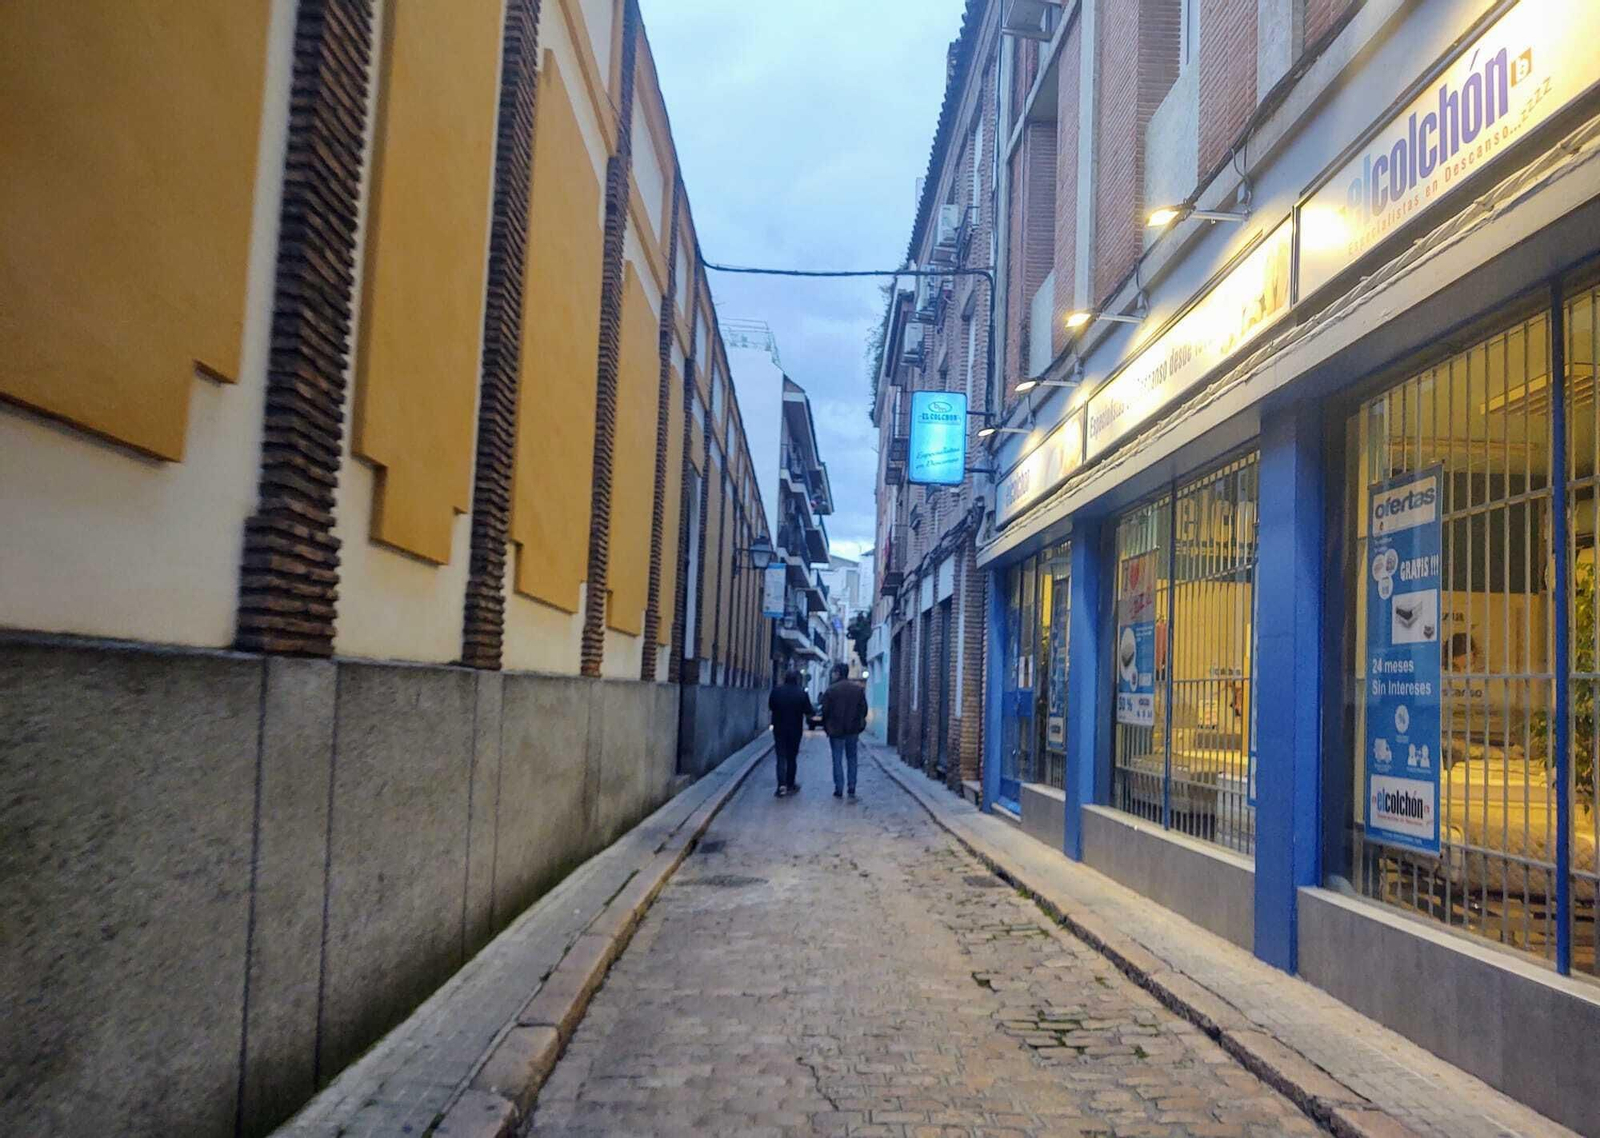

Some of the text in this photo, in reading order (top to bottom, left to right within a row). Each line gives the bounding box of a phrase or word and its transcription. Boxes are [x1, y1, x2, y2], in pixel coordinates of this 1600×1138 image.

[1425, 178, 1439, 196] en
[1374, 486, 1436, 520] ofertas
[1400, 556, 1429, 582] GRATIS
[1372, 658, 1415, 674] 24 meses
[1371, 679, 1432, 696] Sin Intereses
[1376, 786, 1424, 820] elcolchón
